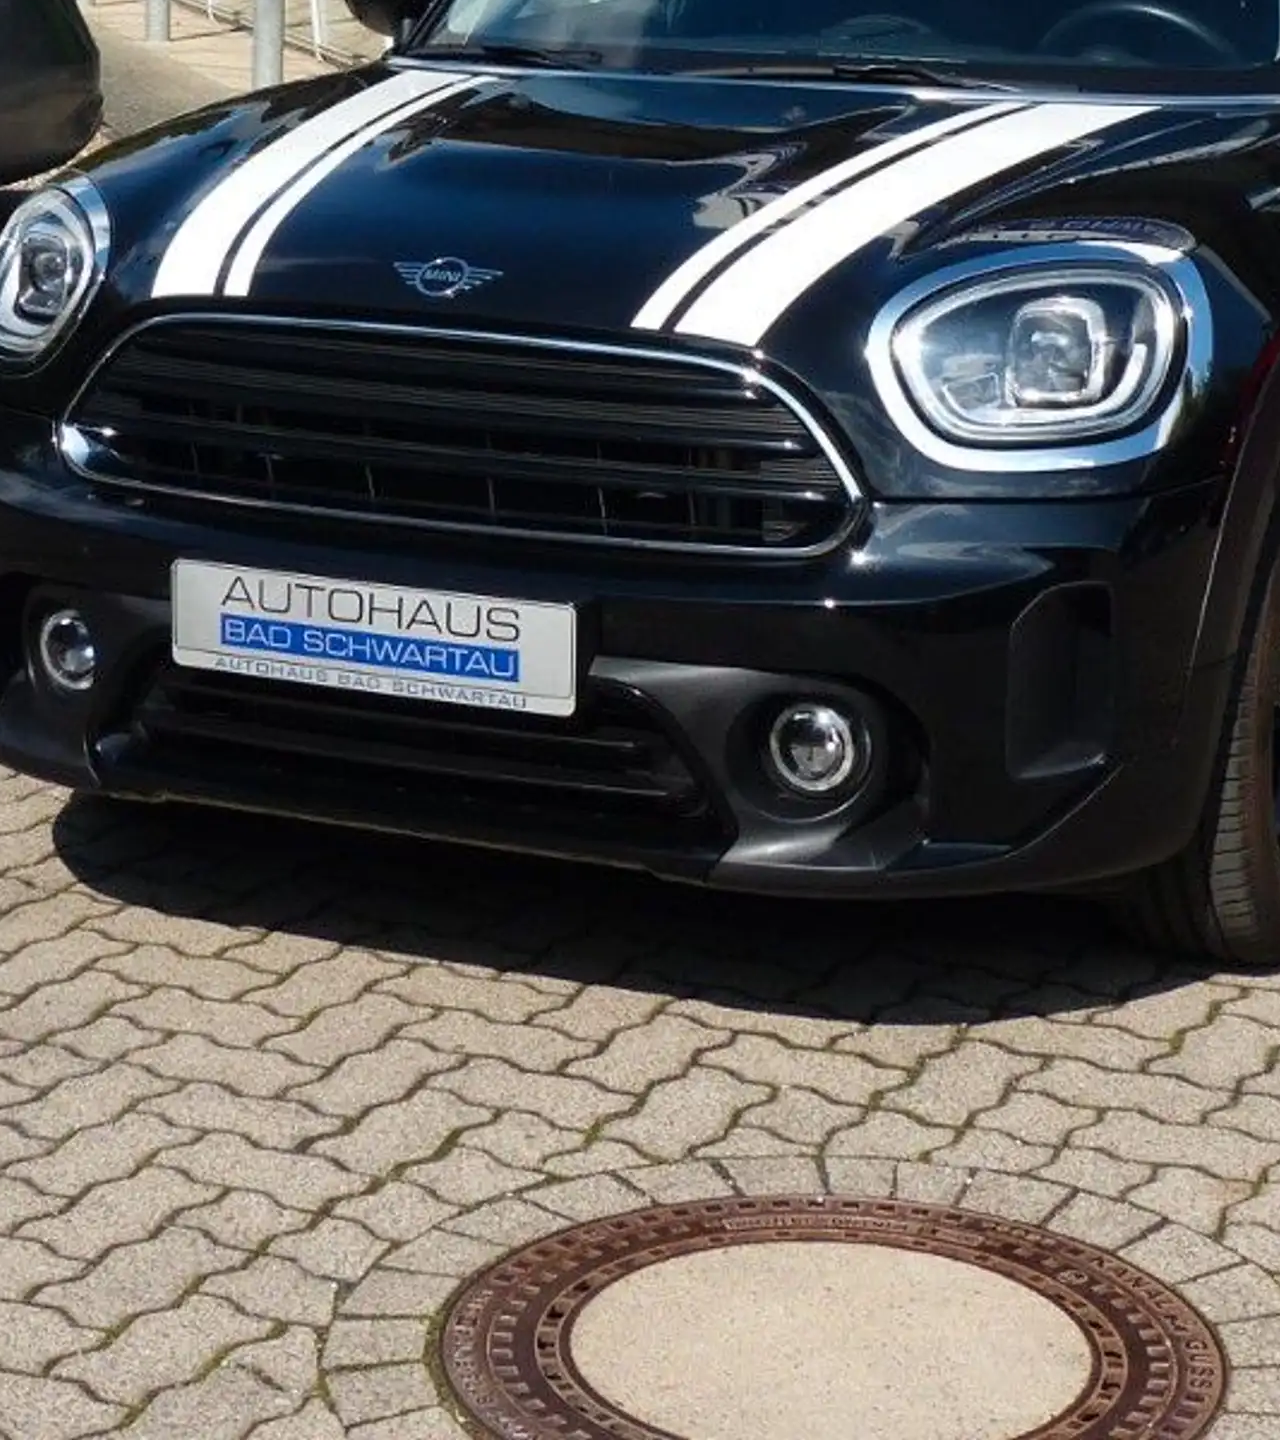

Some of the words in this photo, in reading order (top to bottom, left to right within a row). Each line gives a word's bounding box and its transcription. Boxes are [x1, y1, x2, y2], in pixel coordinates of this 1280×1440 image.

[221, 576, 520, 642] AUTOHAUS
[224, 620, 291, 649] BAD
[303, 630, 516, 677] SCHWARTAU
[215, 657, 328, 684] AUTOHAUS
[337, 674, 380, 691] BAD
[392, 681, 527, 710] SCHWARTAU
